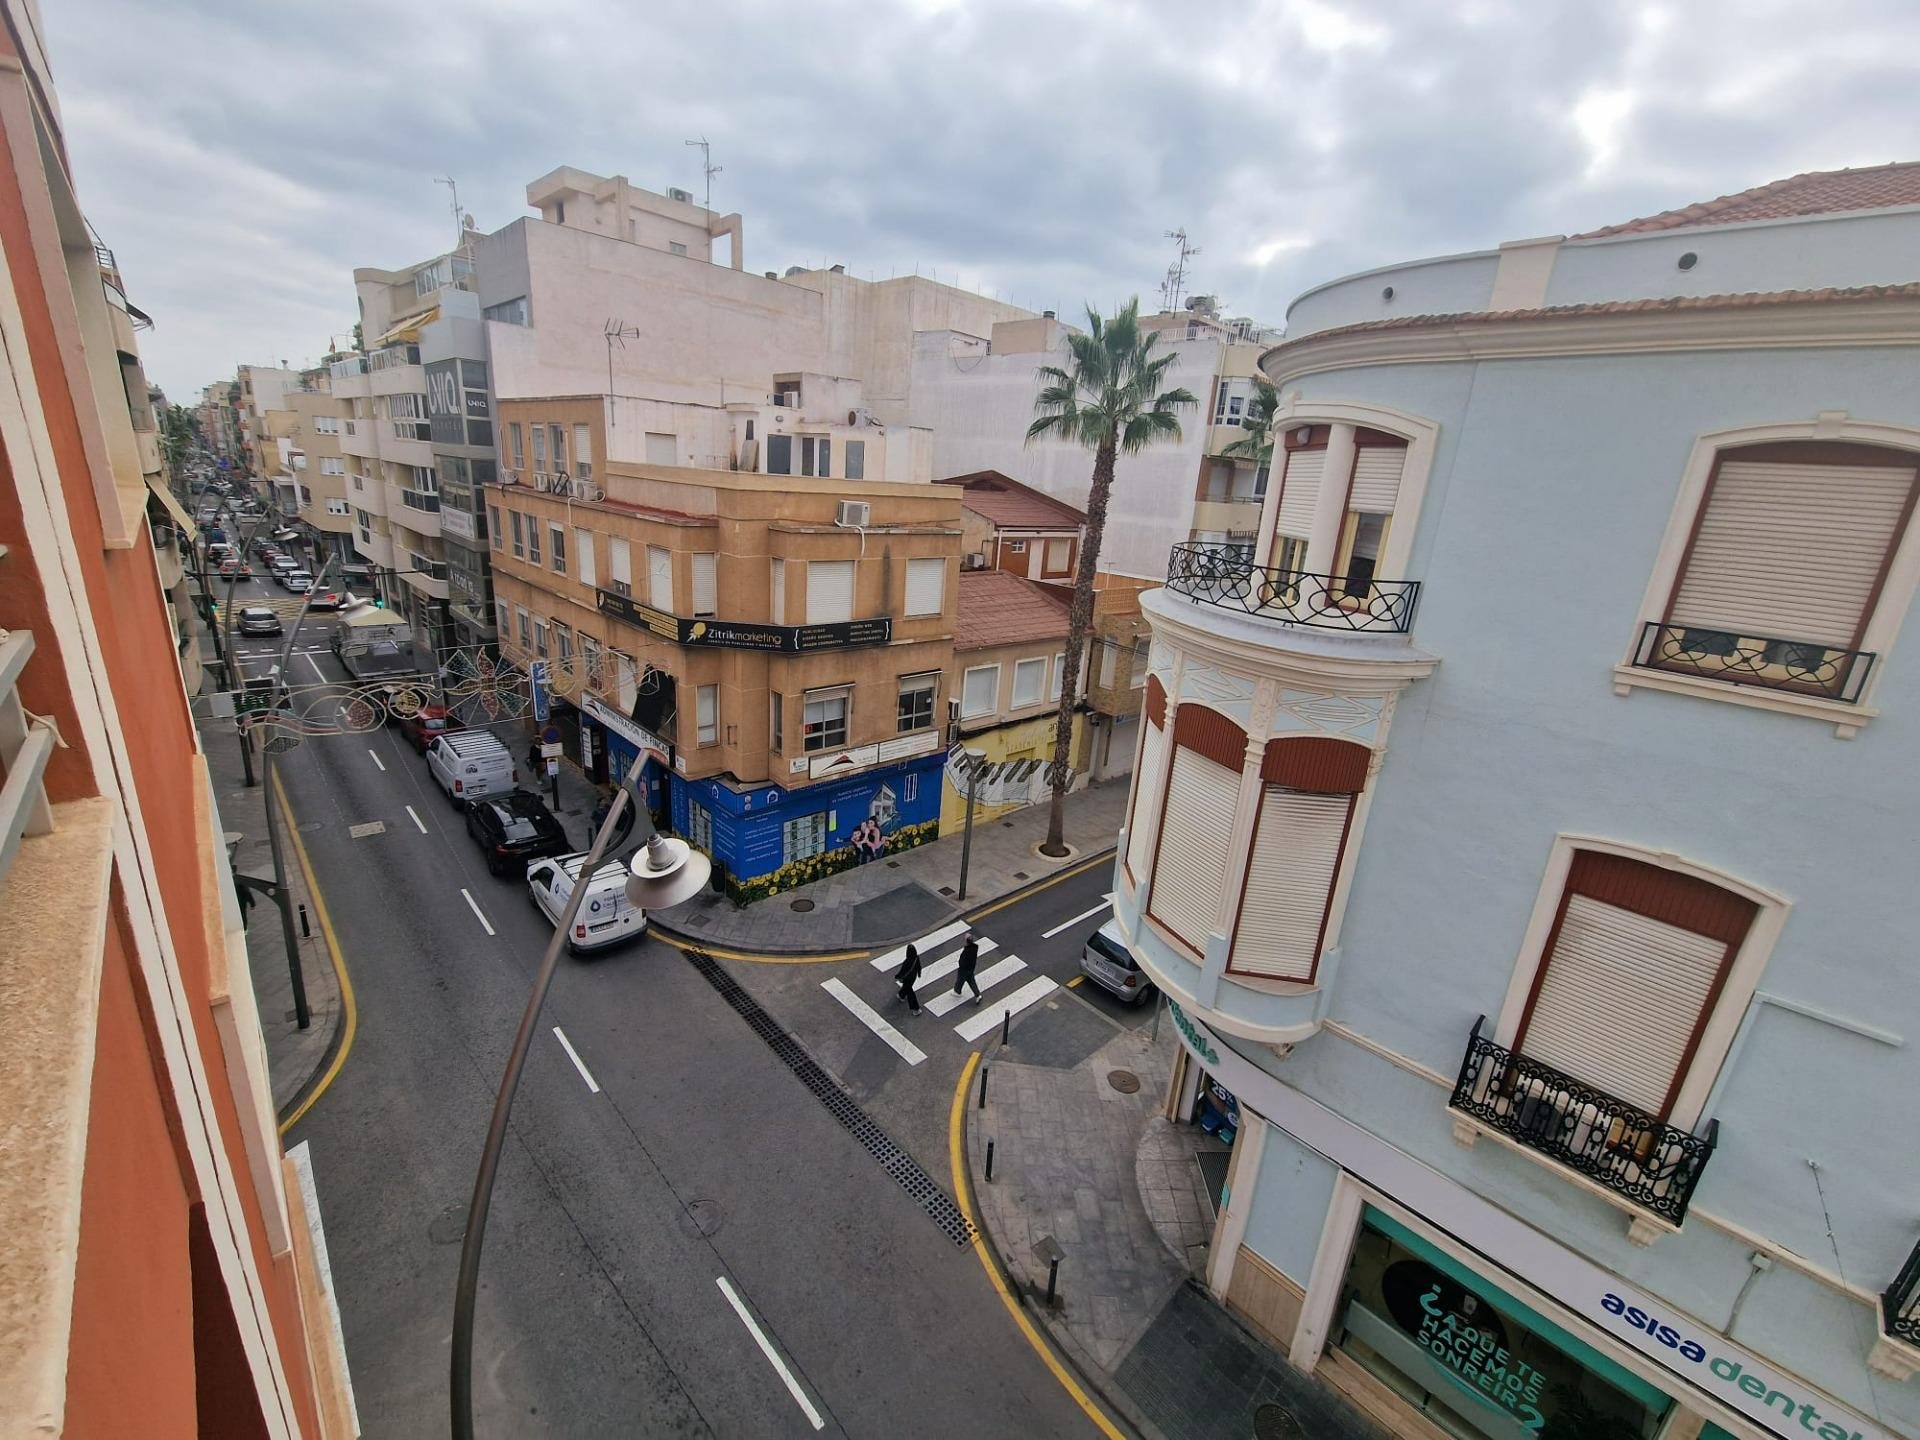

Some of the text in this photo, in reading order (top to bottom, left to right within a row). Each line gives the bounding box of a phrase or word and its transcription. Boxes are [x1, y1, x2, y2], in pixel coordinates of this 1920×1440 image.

[708, 628, 782, 645] Zitrikmarketing
[1422, 1314, 1541, 1404] HACEMOS
[1518, 1360, 1546, 1390] TE
[1600, 1292, 1864, 1440] asisa denta
